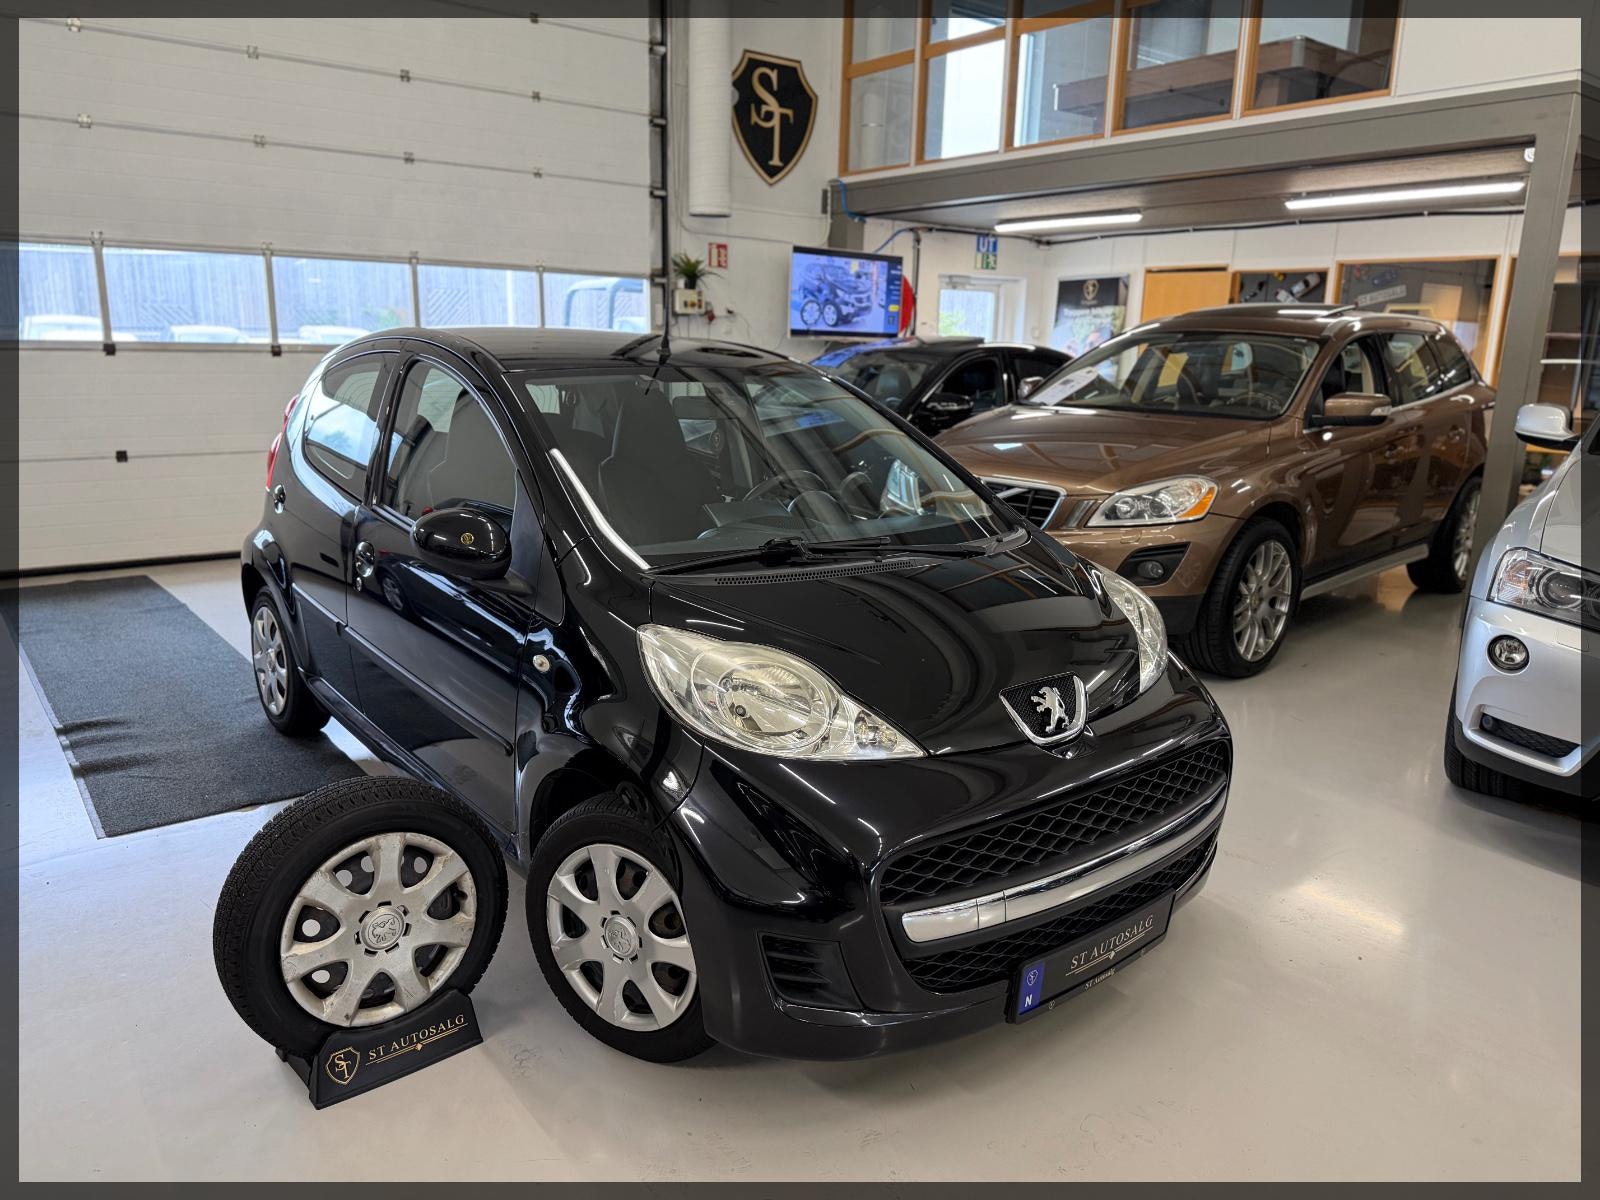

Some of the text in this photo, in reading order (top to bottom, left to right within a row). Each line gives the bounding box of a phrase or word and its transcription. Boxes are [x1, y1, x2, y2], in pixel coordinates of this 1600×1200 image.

[980, 236, 997, 252] UT
[1071, 915, 1153, 969] ST AUTOSALG
[1024, 994, 1033, 1008] N
[369, 1014, 465, 1060] ST AUTOSALG
